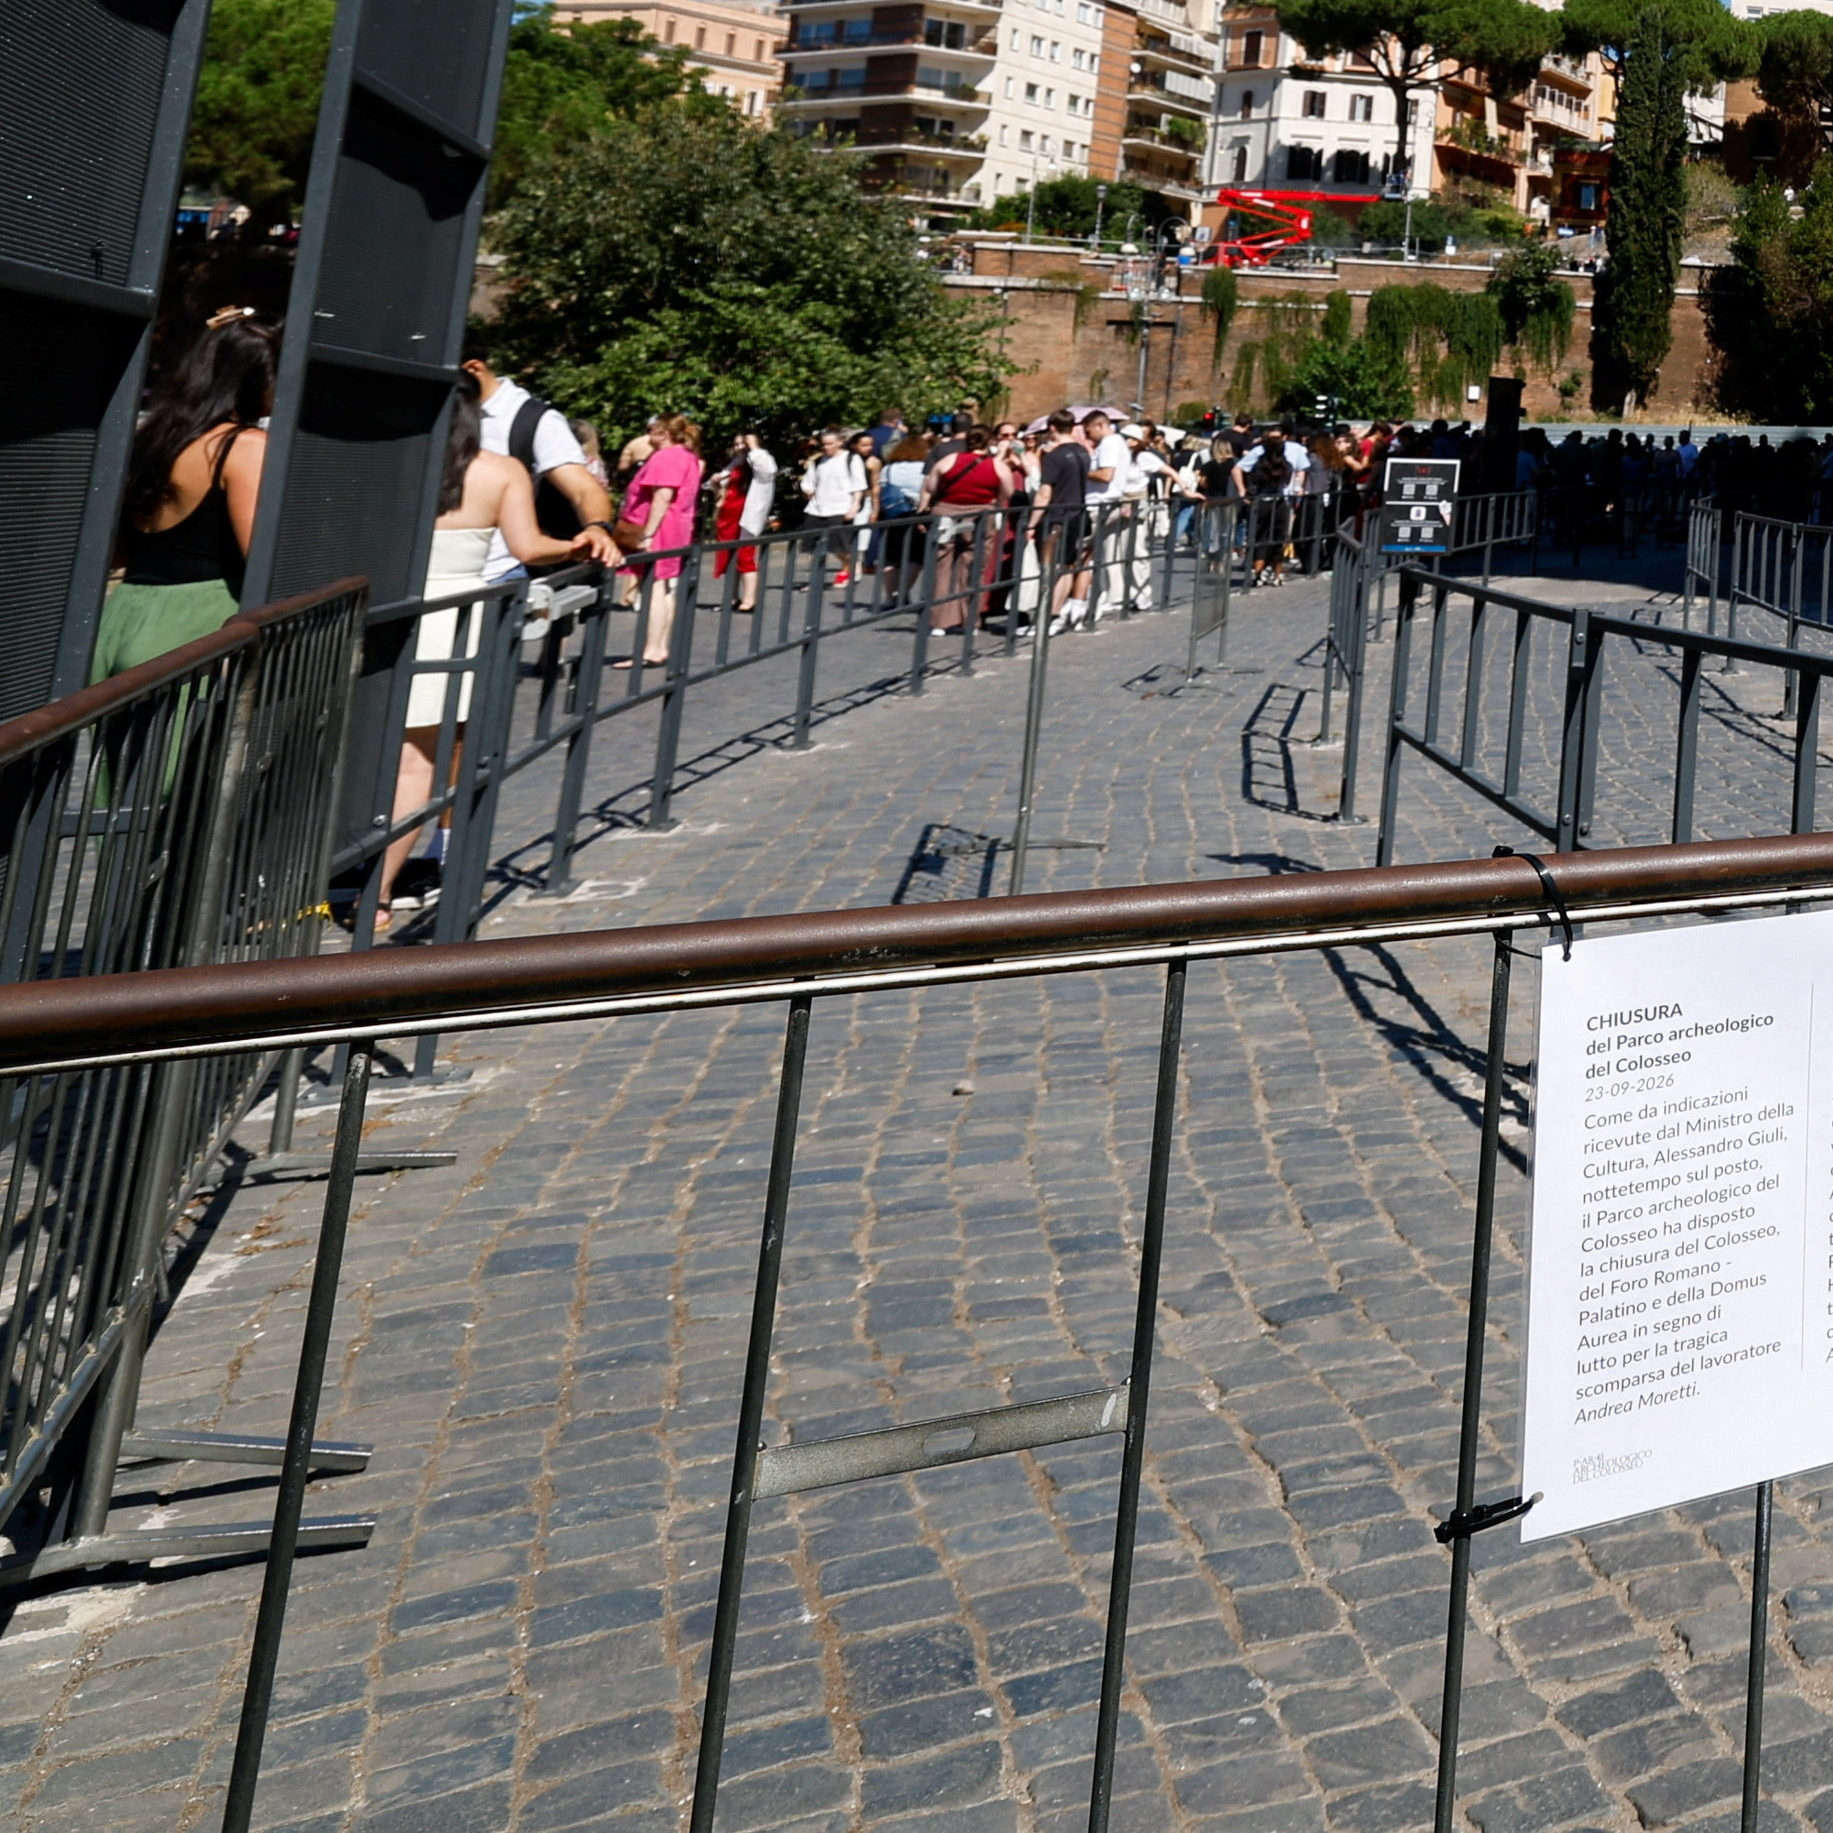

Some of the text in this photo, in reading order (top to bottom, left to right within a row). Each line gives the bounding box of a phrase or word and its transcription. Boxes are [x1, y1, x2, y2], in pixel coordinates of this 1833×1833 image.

[1586, 1014, 1774, 1056] del Parco archeologico
[1587, 1003, 1683, 1031] CHIUSURA
[1585, 1073, 1674, 1102] 23-09-2026
[1586, 1051, 1691, 1079] del Colosseo
[1584, 1086, 1747, 1129] Come da indicazioni
[1584, 1102, 1793, 1155] ricevute dal Ministro della
[1583, 1126, 1787, 1178] Cultura, Alessandro Giuli,
[1583, 1158, 1762, 1204] nottetempo sul posto,
[1583, 1174, 1779, 1229] il Parco archeologico del
[1580, 1225, 1780, 1278] la chiusura del Colosseo,
[1581, 1206, 1755, 1253] Colosseo ha disposto
[1579, 1282, 1604, 1302] del
[1611, 1278, 1648, 1295] Foro
[1654, 1262, 1720, 1286] Romano
[1579, 1274, 1767, 1326] Palatino e della Domus
[1577, 1304, 1721, 1351] Aurea in segno di
[1576, 1341, 1781, 1400] scomparsa del lavoratore
[1577, 1331, 1727, 1375] lutto per la tragica
[1574, 1381, 1700, 1425] Andrea Moretti.
